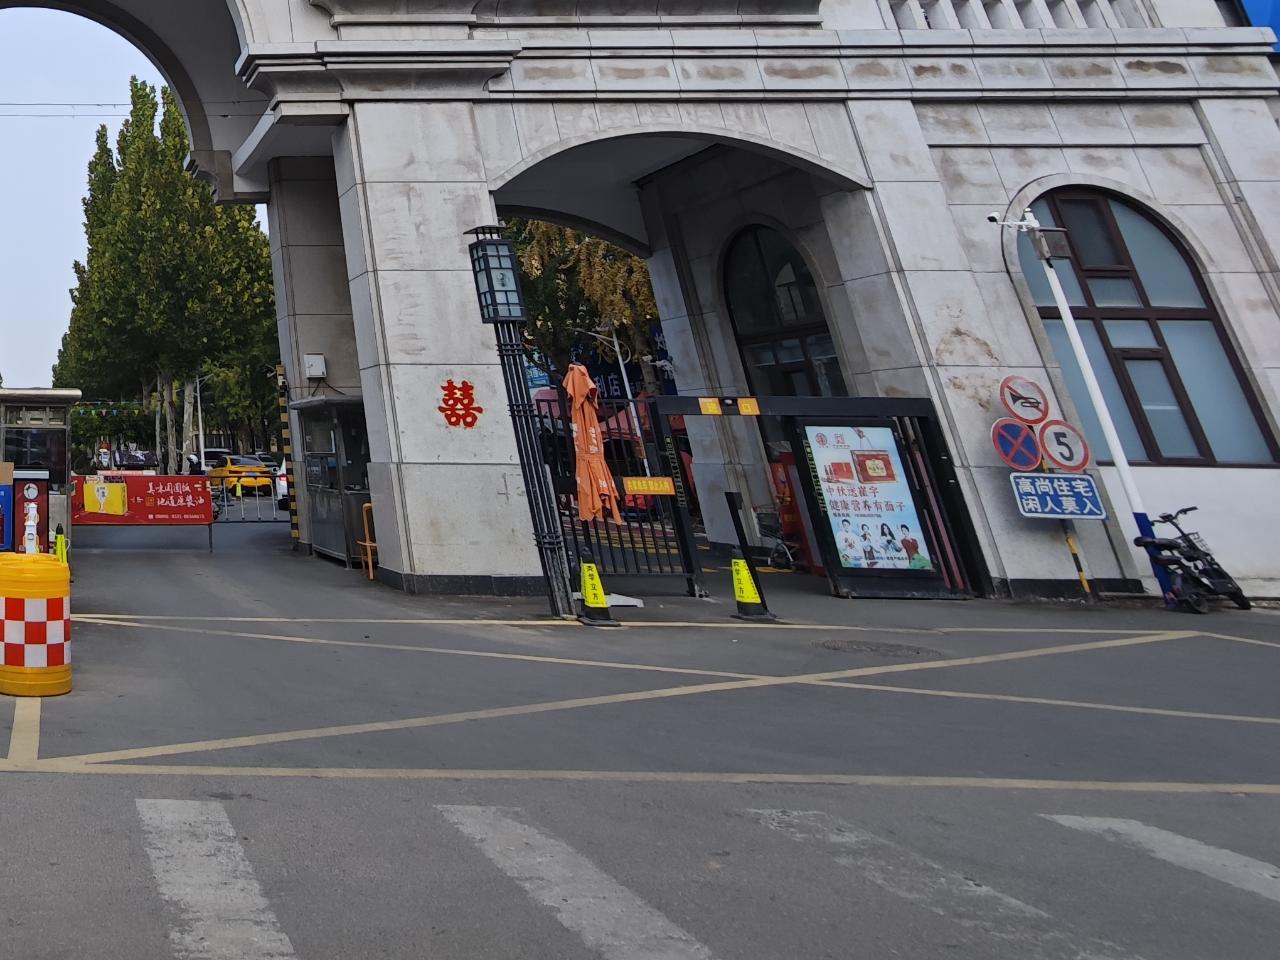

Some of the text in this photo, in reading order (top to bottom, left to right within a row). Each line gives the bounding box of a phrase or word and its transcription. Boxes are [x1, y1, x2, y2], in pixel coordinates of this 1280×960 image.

[1053, 431, 1074, 461] 5
[1015, 477, 1093, 497] 高尚住宅
[829, 500, 907, 513] 健康营养有面子
[1022, 496, 1101, 514] 闲人莫入
